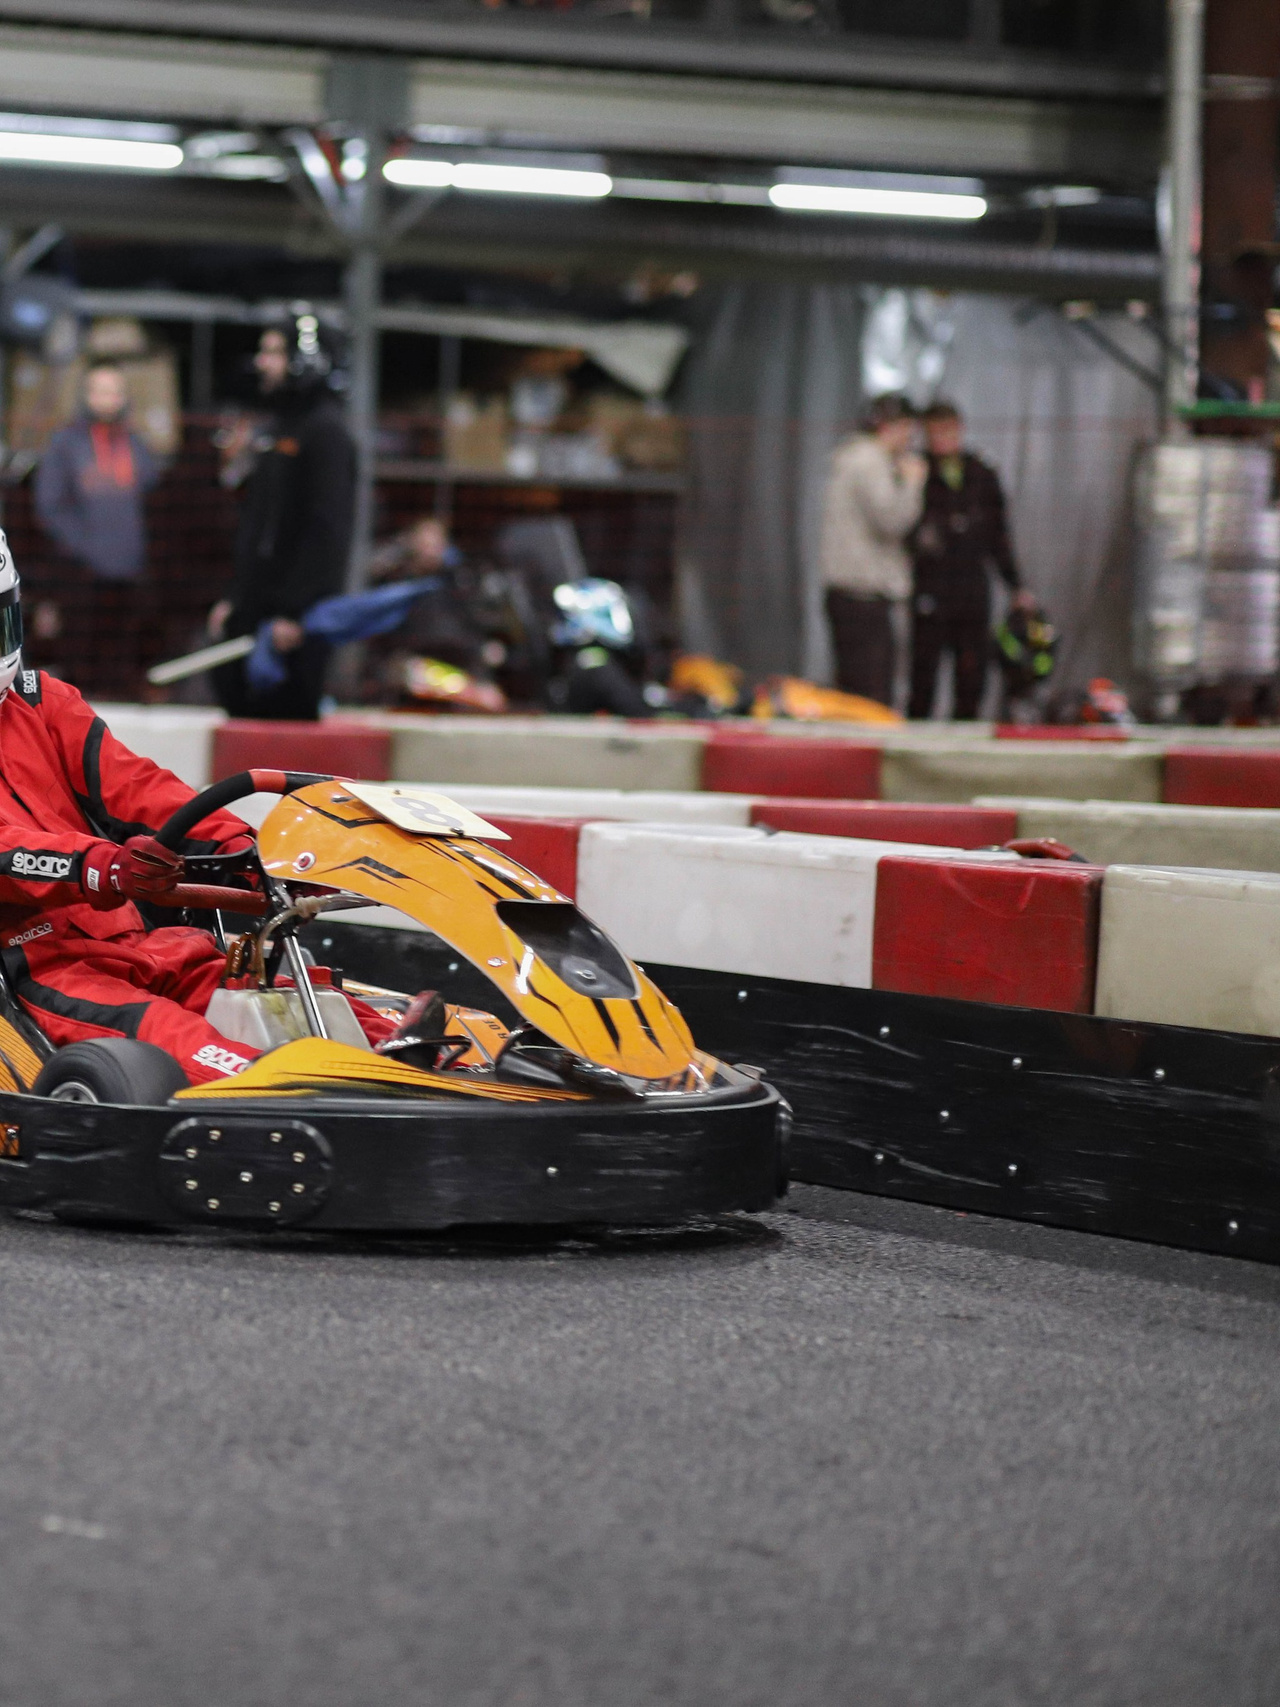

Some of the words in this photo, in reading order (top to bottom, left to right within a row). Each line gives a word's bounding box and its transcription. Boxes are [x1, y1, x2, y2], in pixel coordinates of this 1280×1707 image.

[391, 796, 463, 827] 8
[11, 852, 72, 878] sparc
[8, 922, 54, 946] sparco
